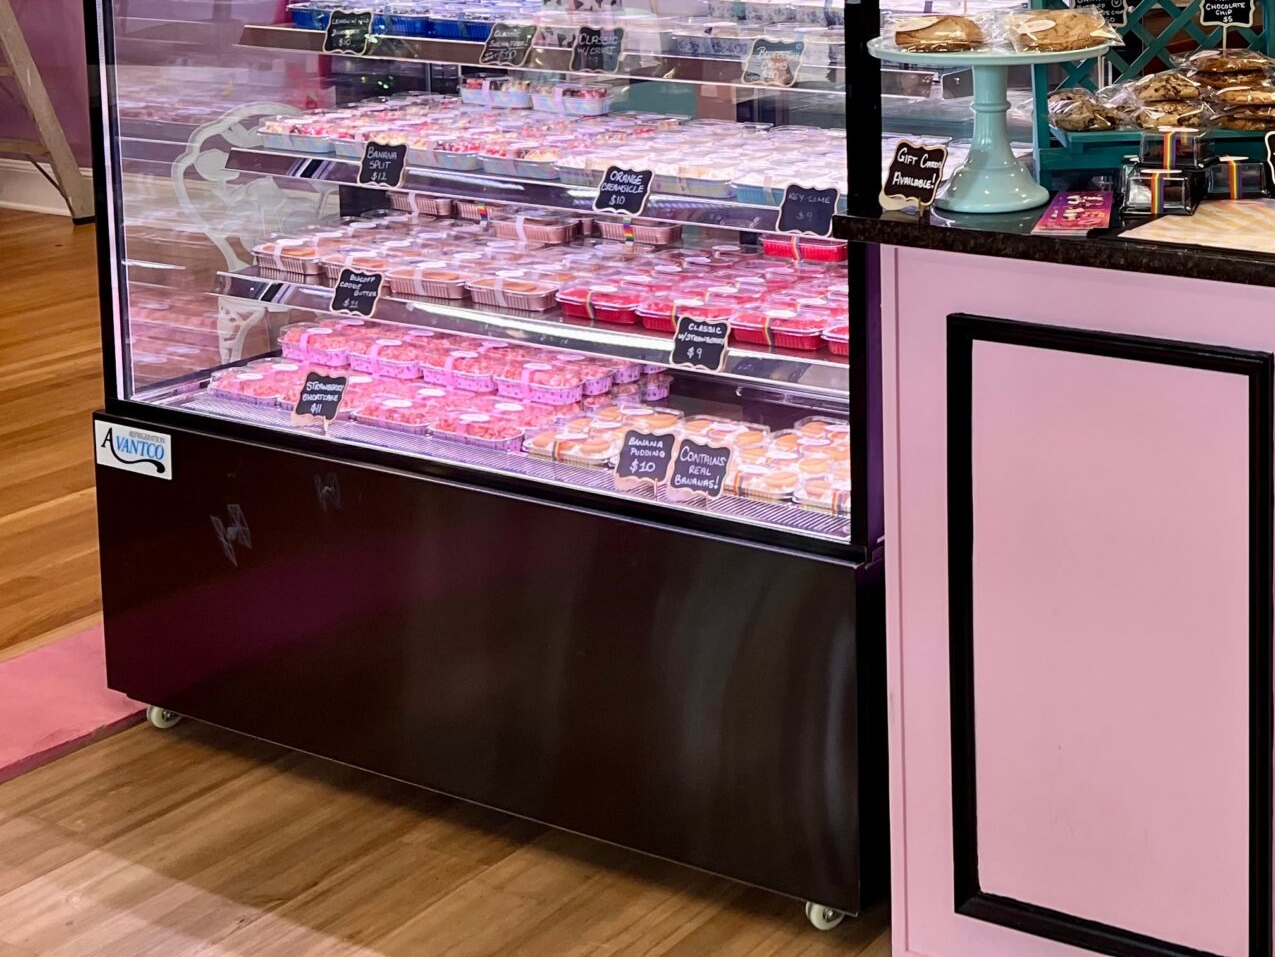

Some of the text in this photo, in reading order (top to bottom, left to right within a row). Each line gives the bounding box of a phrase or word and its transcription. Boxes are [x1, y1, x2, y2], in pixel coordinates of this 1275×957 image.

[1205, 2, 1246, 10] CHOCOLATE
[578, 32, 619, 46] CLASSIC
[367, 147, 397, 160] BANANA
[897, 147, 917, 165] GIFT
[369, 160, 391, 169] SPLIT
[371, 172, 387, 181] $12
[609, 171, 643, 185] ORANGE
[892, 171, 937, 189] AVAILABLE!
[601, 183, 645, 193] CREAMSICLE
[609, 195, 626, 205] $10
[350, 273, 376, 282] BISCOFF
[339, 281, 362, 290] COOKIE
[354, 290, 377, 298] BUTTER
[688, 323, 723, 335] CLASSIC
[306, 381, 345, 392] STRAWBERRY
[302, 394, 339, 402] SHORTCAKE
[310, 403, 323, 413] $11
[129, 430, 166, 444] REFRIGERATION
[628, 437, 663, 449] BANANA
[101, 427, 166, 474] AVANTCO
[630, 448, 666, 458] PUDDING
[680, 445, 727, 466] CONTAINS
[629, 458, 656, 474] $10
[689, 466, 711, 476] REAL
[674, 475, 720, 490] BANANAS!
